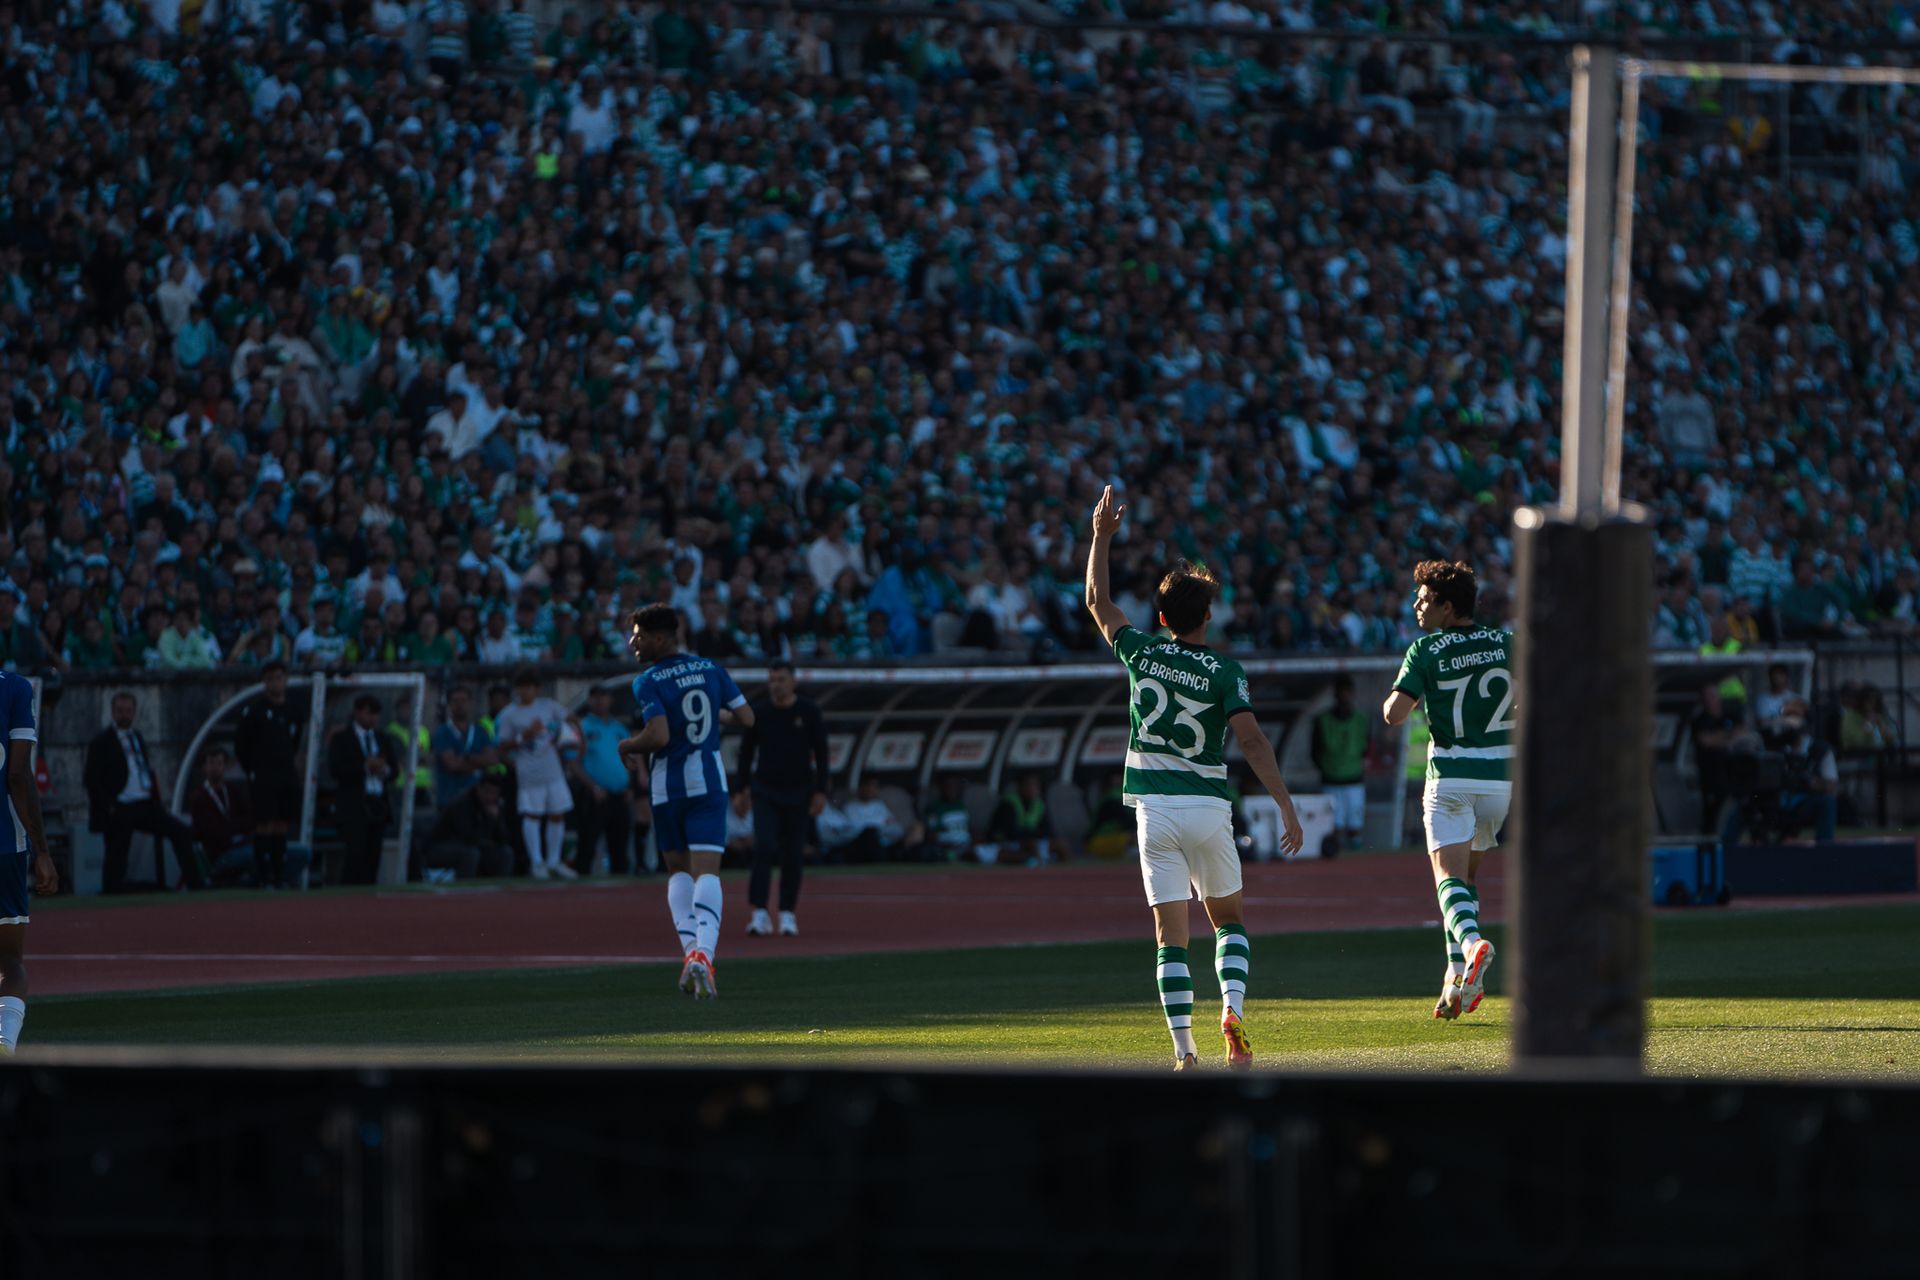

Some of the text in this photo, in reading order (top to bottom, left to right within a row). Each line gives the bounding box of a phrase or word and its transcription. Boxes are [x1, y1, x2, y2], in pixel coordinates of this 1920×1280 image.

[1428, 632, 1466, 655] SUPER
[1438, 648, 1506, 672] E. QUARESMA
[651, 660, 715, 682] SUPER BOCK
[682, 689, 712, 745] 9
[1133, 677, 1215, 759] 23
[1436, 667, 1517, 738] 72
